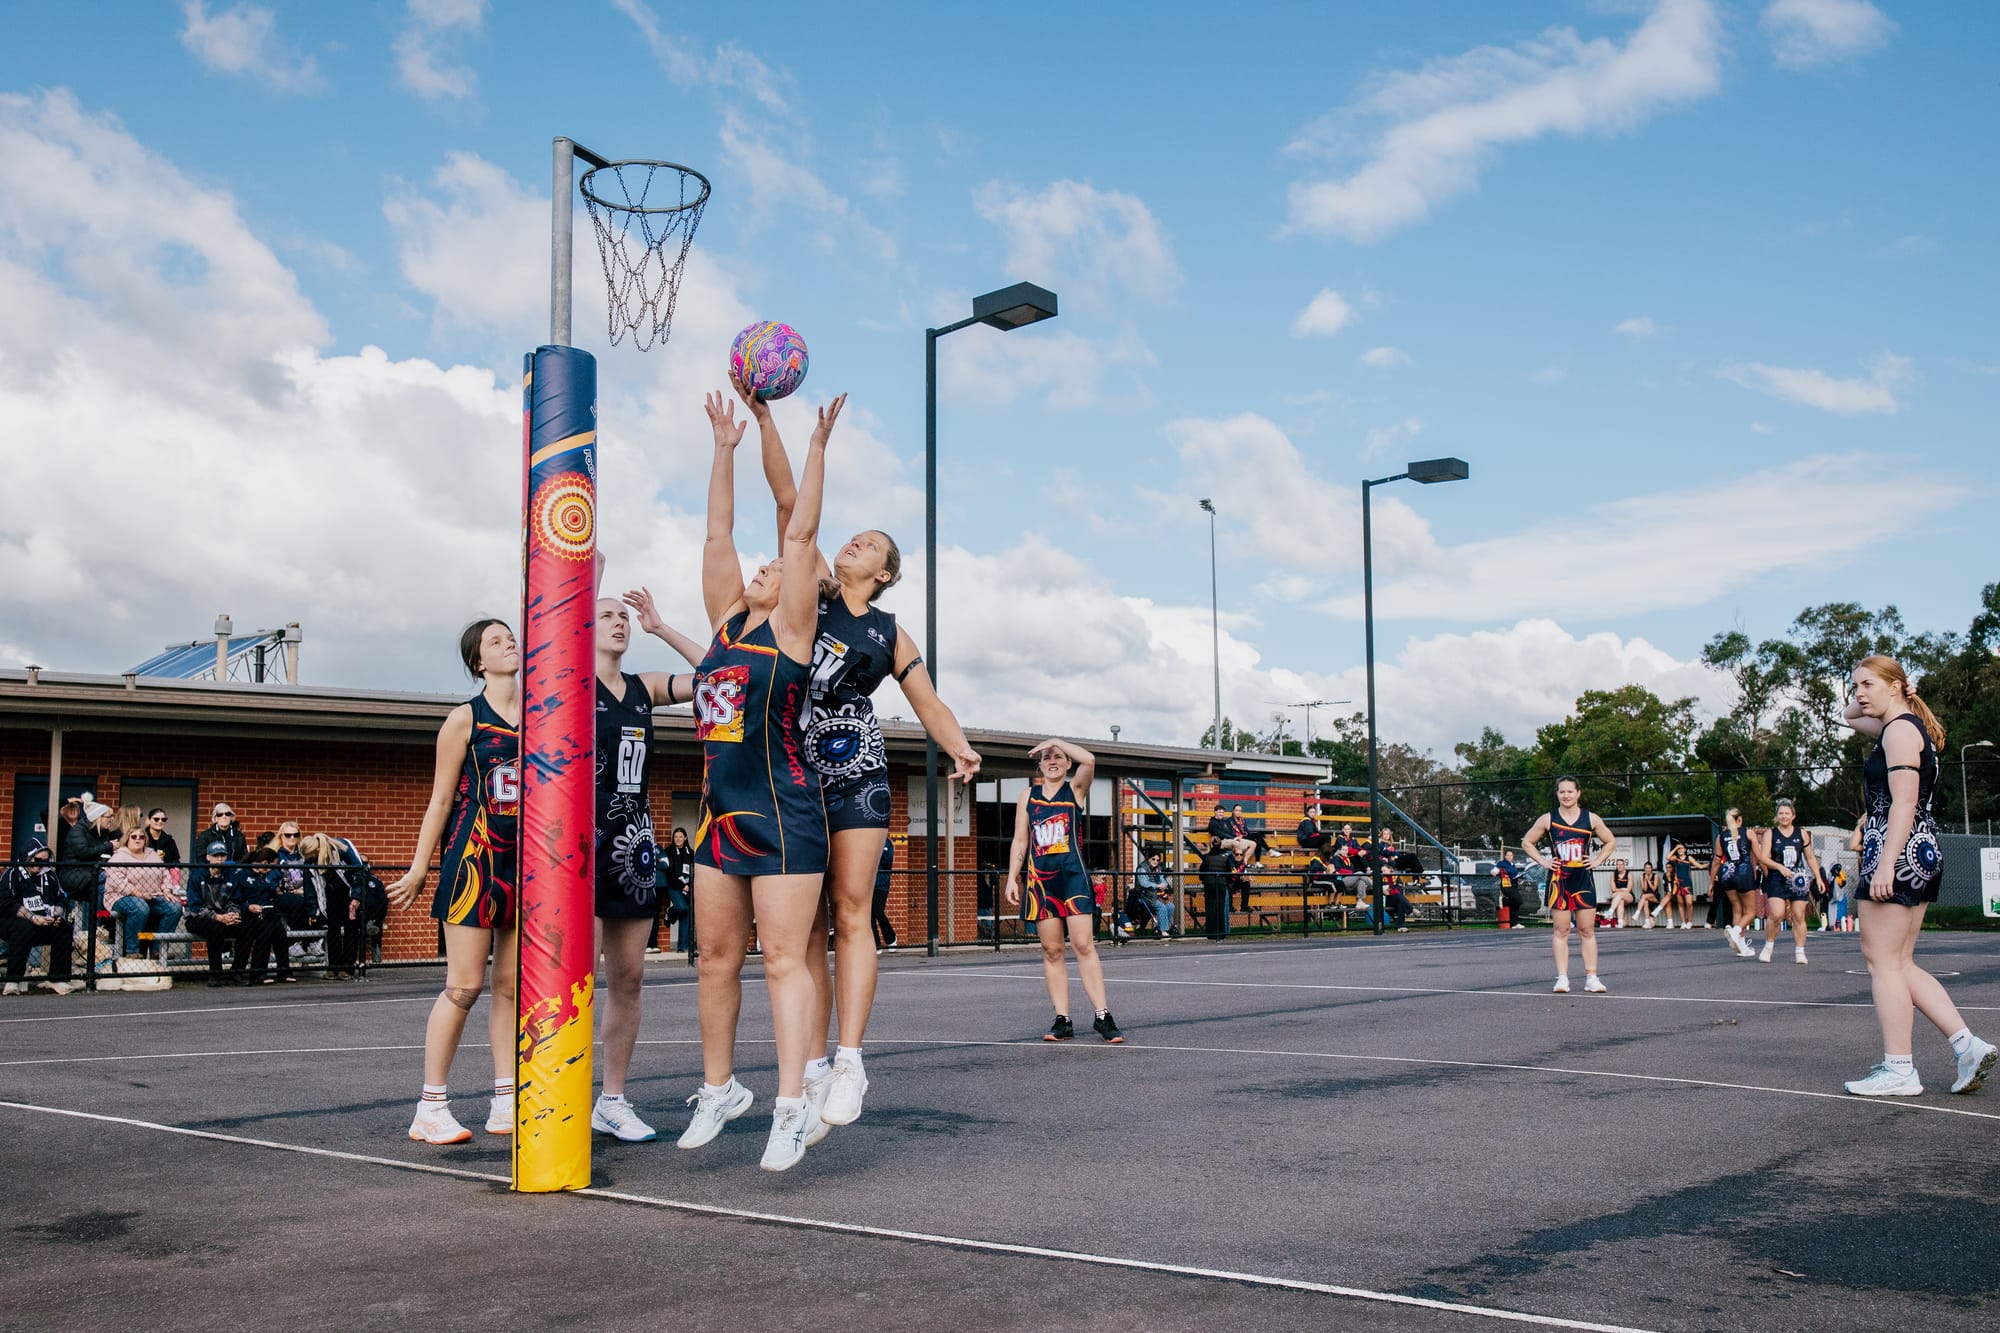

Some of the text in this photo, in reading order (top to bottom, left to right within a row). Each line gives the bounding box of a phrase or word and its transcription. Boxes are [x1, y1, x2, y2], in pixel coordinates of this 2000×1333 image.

[617, 740, 646, 784] GD
[1034, 820, 1065, 848] WA
[1557, 843, 1582, 862] WD
